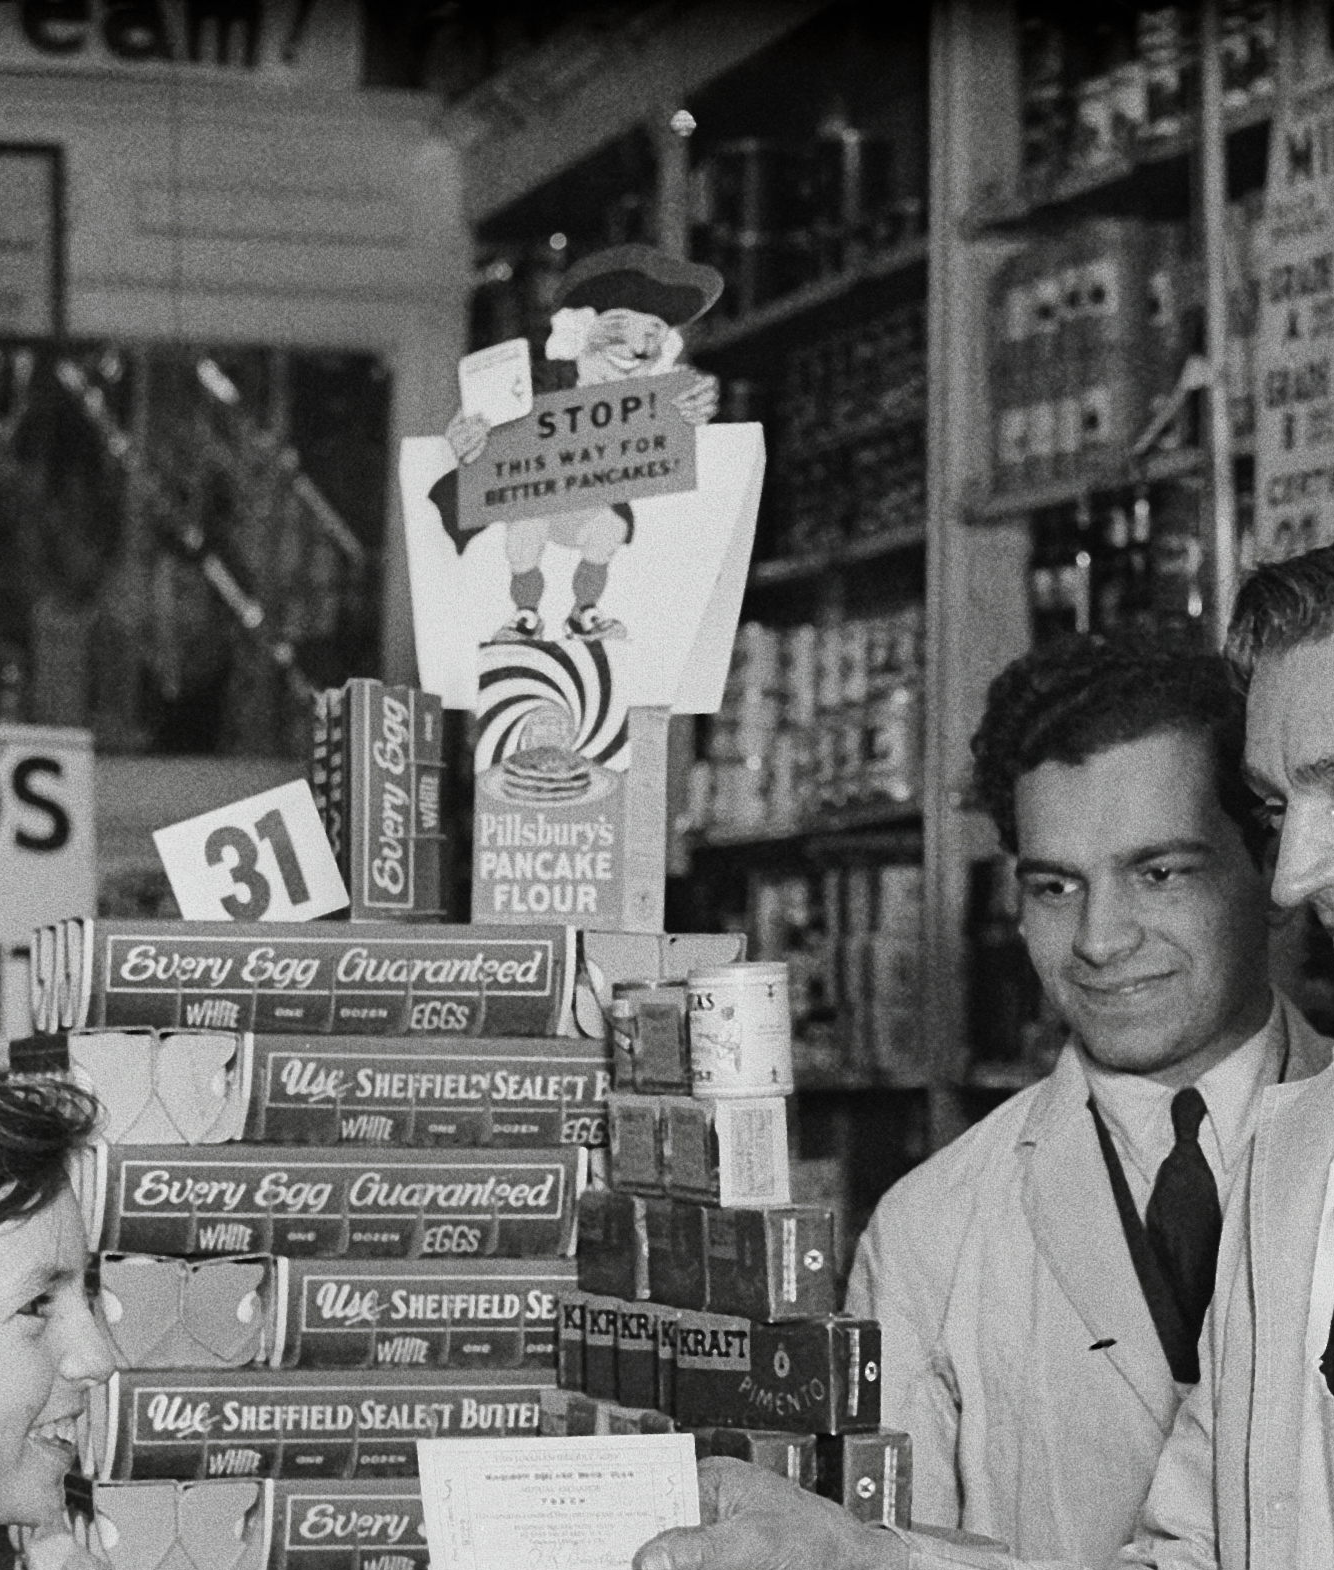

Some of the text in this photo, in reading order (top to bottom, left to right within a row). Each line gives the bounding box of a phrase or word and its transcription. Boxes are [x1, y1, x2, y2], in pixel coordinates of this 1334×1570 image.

[538, 391, 657, 439] STOP!
[495, 434, 667, 478] THIS WAY FOR
[485, 478, 557, 506] BETTER
[373, 695, 410, 775] Egg
[372, 781, 411, 896] Every
[478, 813, 614, 851] Pillsbury's
[204, 809, 312, 922] 31
[479, 851, 613, 881] PANCAKE
[492, 882, 598, 913] FLOUR
[120, 944, 544, 988] Every Egg Guaranteed
[185, 998, 241, 1029] WHITE
[409, 1000, 470, 1030] EGGS
[280, 1058, 354, 1102] Use
[354, 1067, 490, 1101] SHEFFIELD
[341, 1114, 394, 1141] WHITE
[133, 1169, 555, 1213] Every Egg Guaranteed
[198, 1223, 253, 1253] WHITE
[421, 1224, 483, 1254] EGGS
[316, 1281, 390, 1326] Use
[390, 1289, 520, 1320] SHEFFIELD
[377, 1336, 430, 1364] WHITE
[678, 1328, 749, 1360] KRAFT
[147, 1393, 220, 1438] Use
[222, 1401, 355, 1432] SHEFFIELD
[357, 1400, 454, 1430] SEALECT
[737, 1374, 826, 1417] PIMENTO
[208, 1448, 262, 1476] WHITE
[299, 1502, 410, 1544] Every
